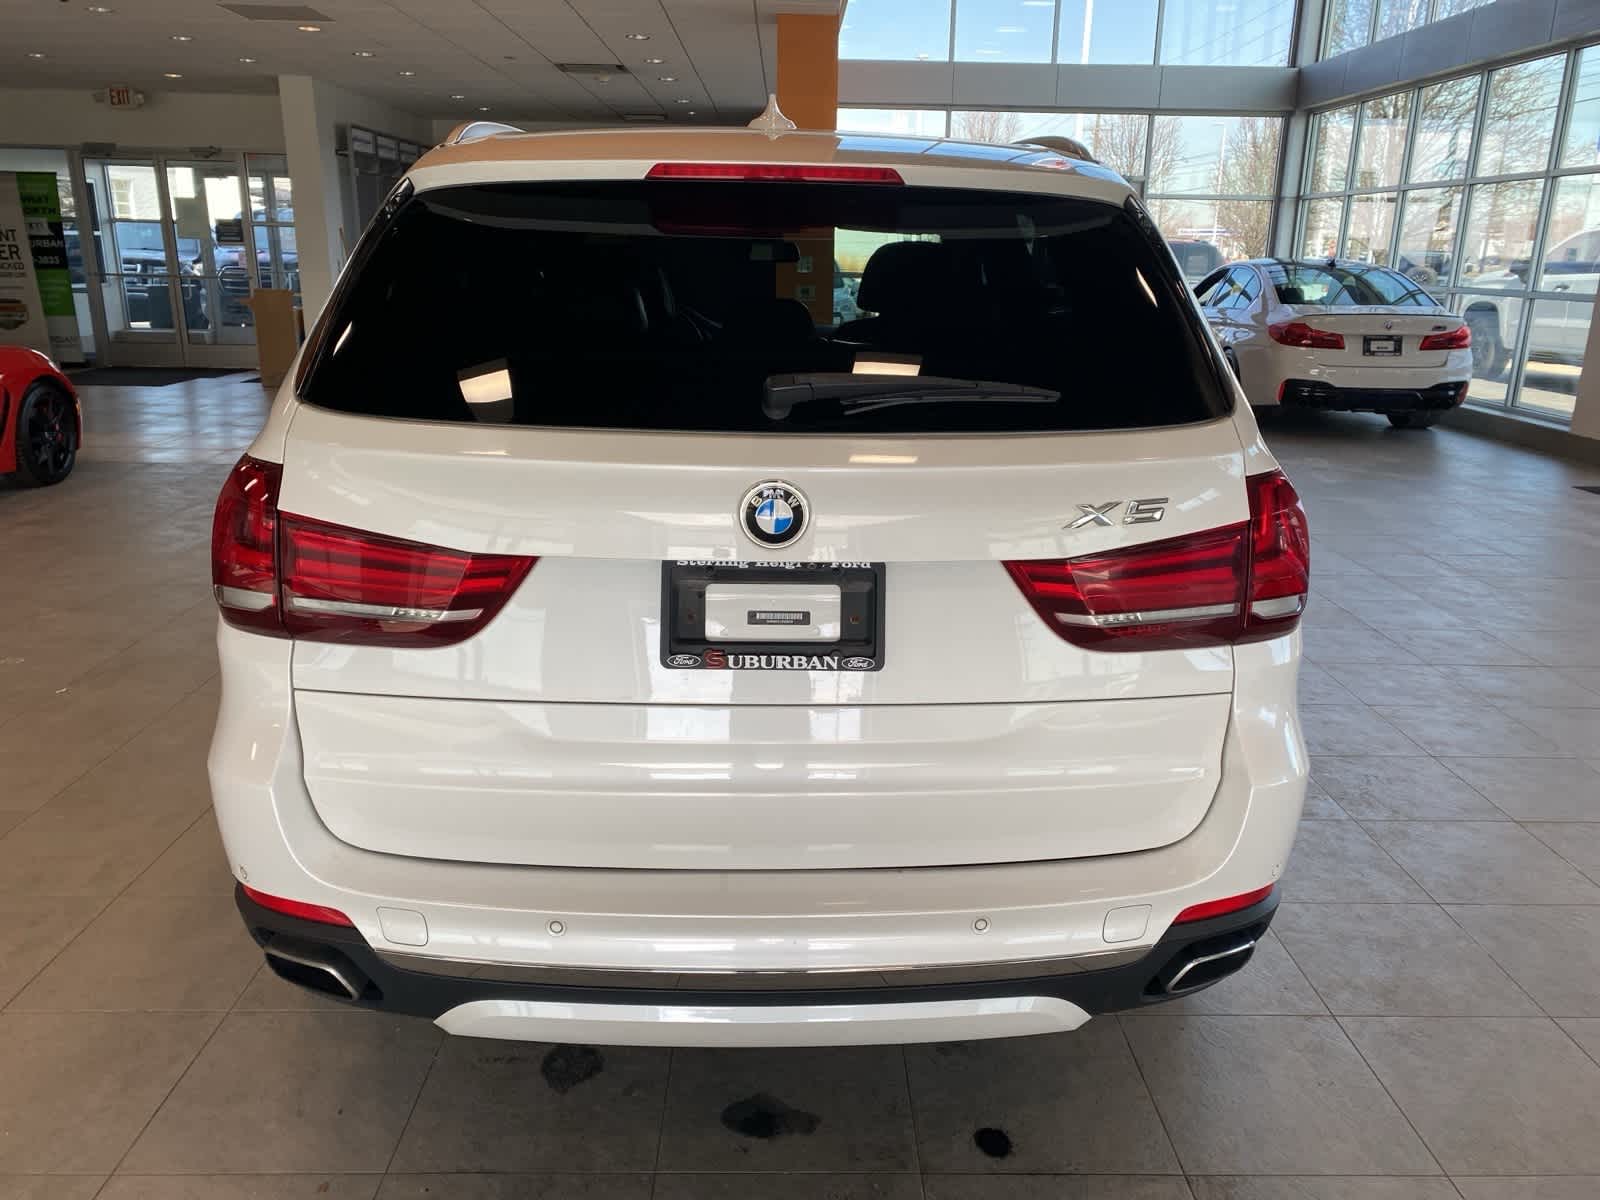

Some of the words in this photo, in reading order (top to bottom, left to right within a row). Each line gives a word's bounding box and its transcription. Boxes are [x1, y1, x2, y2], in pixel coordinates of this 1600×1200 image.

[110, 88, 130, 105] EXIT
[751, 487, 799, 508] BMW
[1062, 498, 1168, 529] X5
[671, 656, 697, 666] Ford
[704, 649, 838, 670] SUBURBAN
[846, 658, 872, 668] Ford
